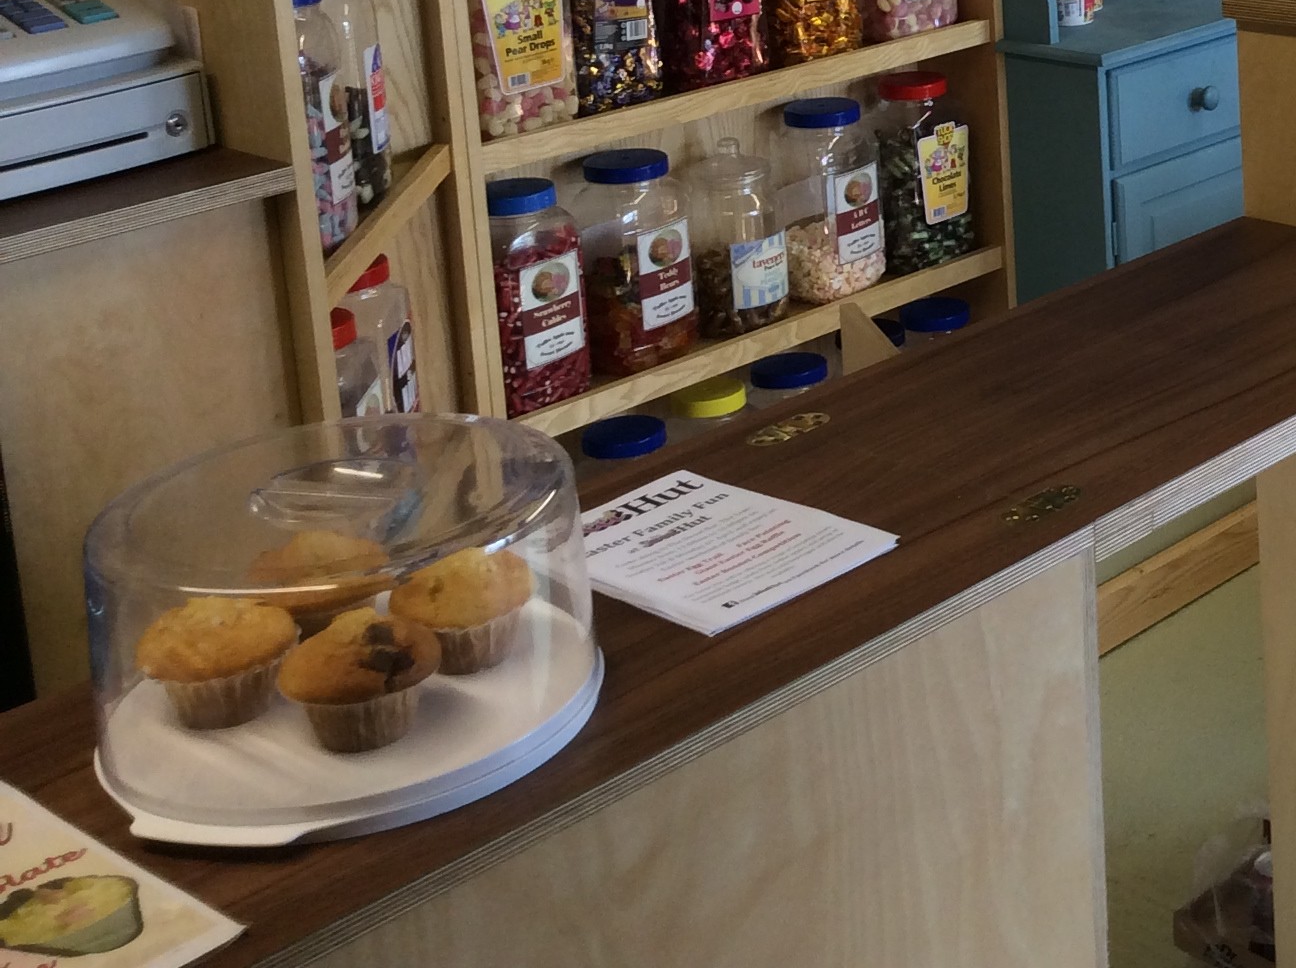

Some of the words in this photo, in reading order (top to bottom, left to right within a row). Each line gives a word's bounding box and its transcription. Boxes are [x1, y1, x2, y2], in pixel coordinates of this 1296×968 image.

[505, 44, 529, 58] Pear
[530, 38, 556, 52] Drops
[517, 32, 544, 45] Small
[932, 170, 962, 186] Chocolate
[939, 181, 957, 192] Limes
[533, 299, 572, 319] Strawberry
[617, 479, 704, 516] Hut
[584, 535, 632, 558] aster
[633, 509, 693, 537] Family
[693, 492, 730, 510] Fun
